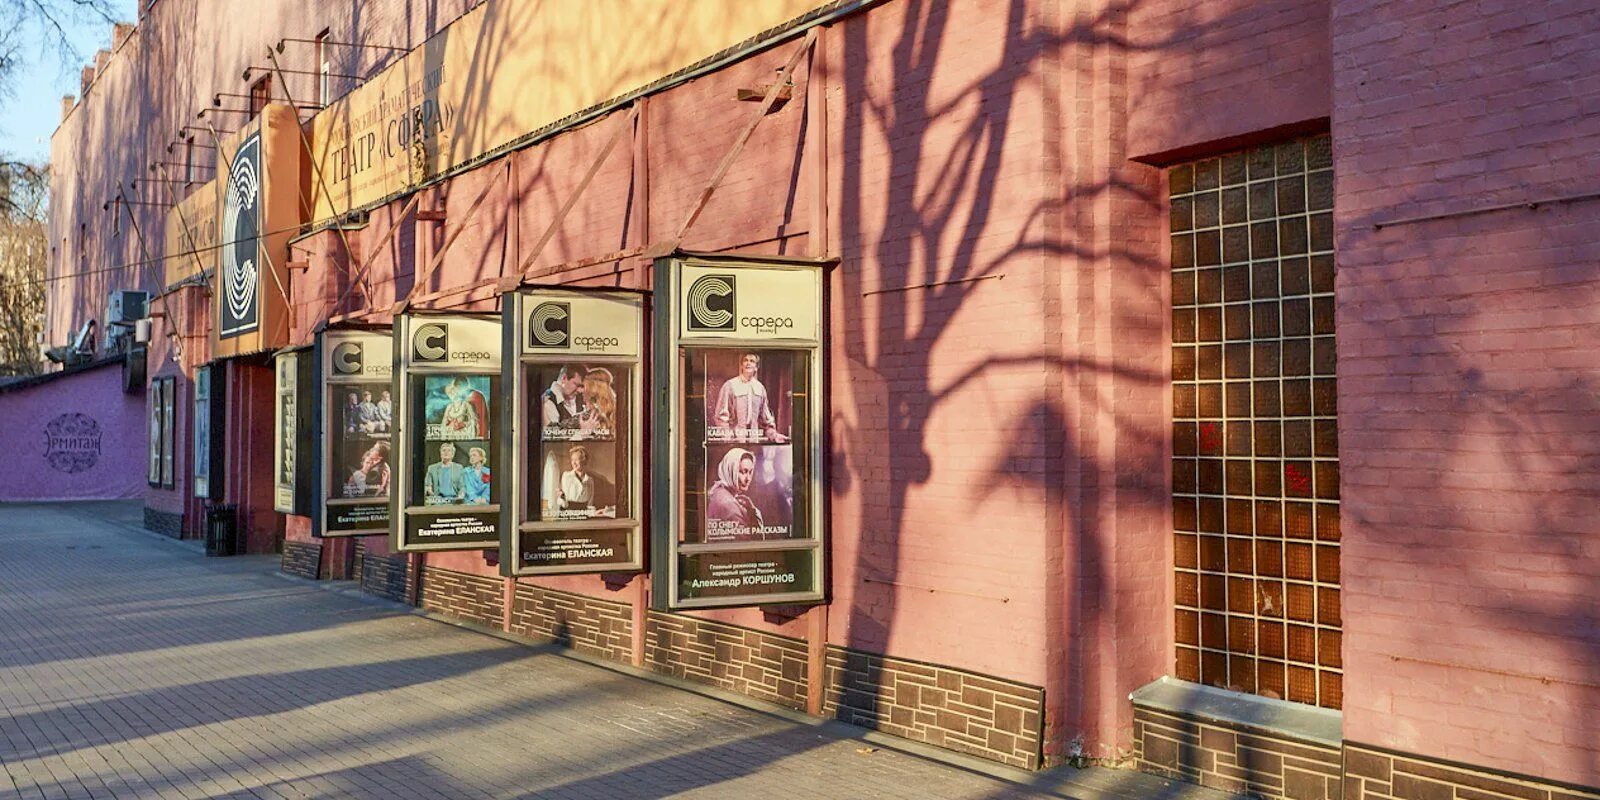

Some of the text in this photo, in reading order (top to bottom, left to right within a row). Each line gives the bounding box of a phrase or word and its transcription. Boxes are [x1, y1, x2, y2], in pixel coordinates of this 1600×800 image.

[332, 132, 376, 185] ТЕАТР
[379, 95, 454, 159] «СФЕРА»
[741, 317, 793, 335] сфера
[574, 336, 619, 351] сфера
[451, 351, 491, 363] сфера
[418, 525, 495, 538] Екатерина ЕЛАНСКАЯ
[707, 526, 788, 536] КОЛЫМСКИЕ РАССКАЗЫ
[524, 548, 614, 560] Екатерина ЕЛАНСКАЯ
[692, 573, 795, 588] Александр КОРШУНОВ
